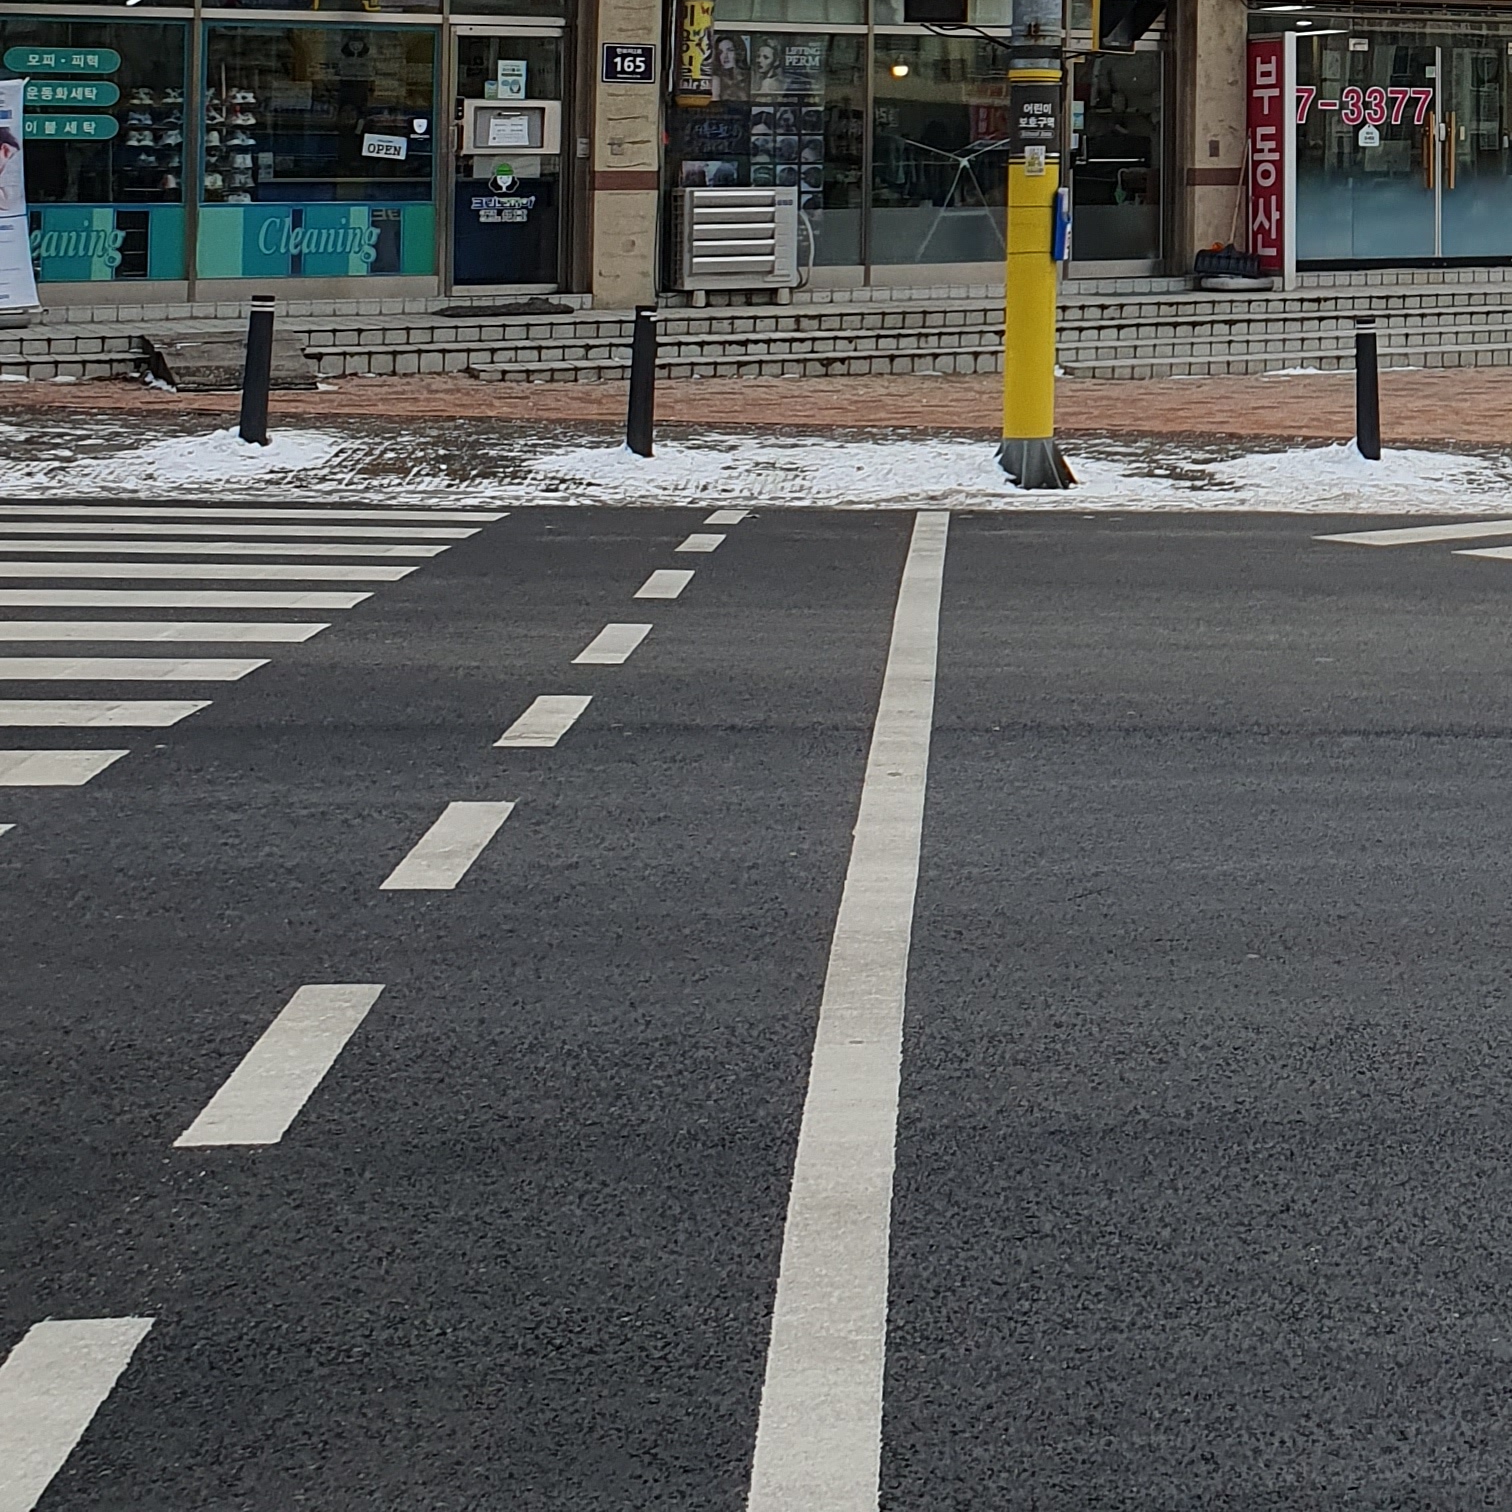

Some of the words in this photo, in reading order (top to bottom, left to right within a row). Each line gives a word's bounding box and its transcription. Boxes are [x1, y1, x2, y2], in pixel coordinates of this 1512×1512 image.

[613, 57, 646, 72] 165
[785, 55, 820, 66] PERM
[26, 86, 98, 101] 운동화세탁
[1023, 103, 1052, 115] 어린이
[1018, 116, 1055, 128] 보호구역
[367, 143, 402, 157] OPEN
[1253, 55, 1281, 256] 부동산
[258, 217, 381, 263] Cleaning
